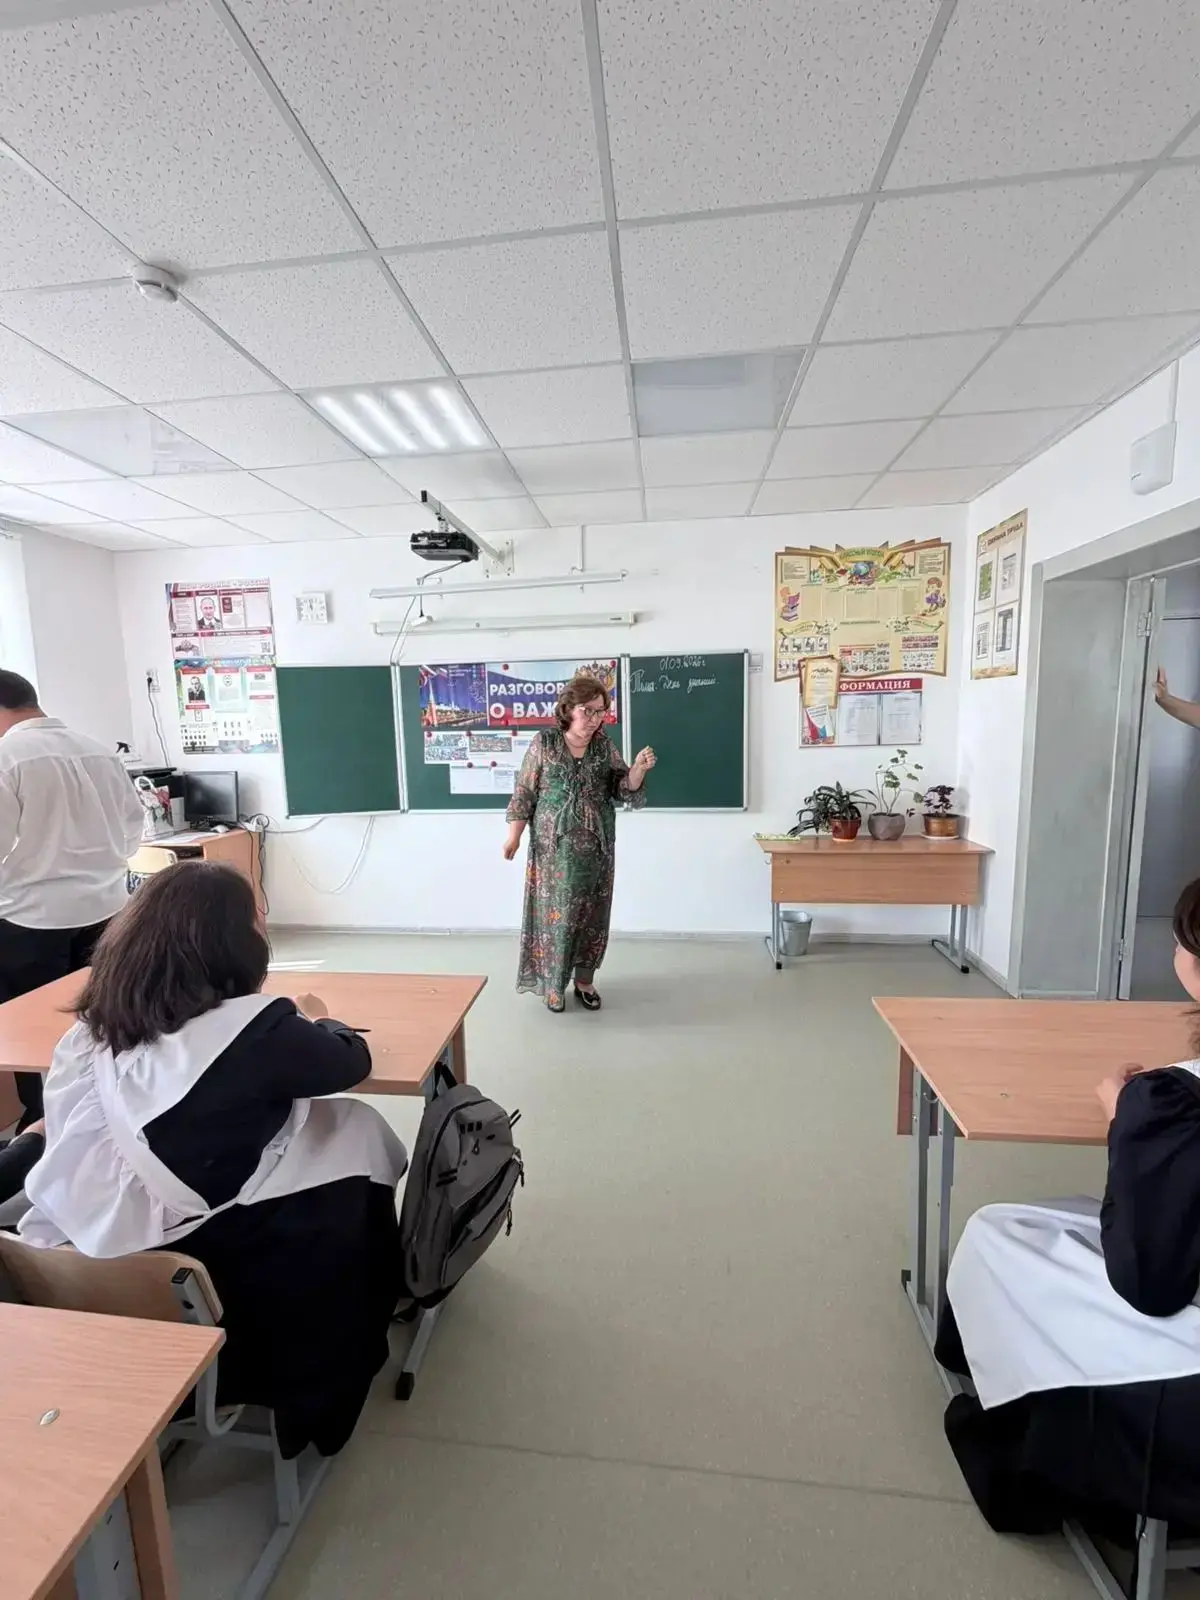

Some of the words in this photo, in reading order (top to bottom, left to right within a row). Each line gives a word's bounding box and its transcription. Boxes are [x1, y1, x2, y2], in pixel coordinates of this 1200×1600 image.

[489, 682, 569, 696] РАЗГОВОР
[839, 680, 911, 692] ФОРМАЦИЯ
[489, 702, 506, 719] О
